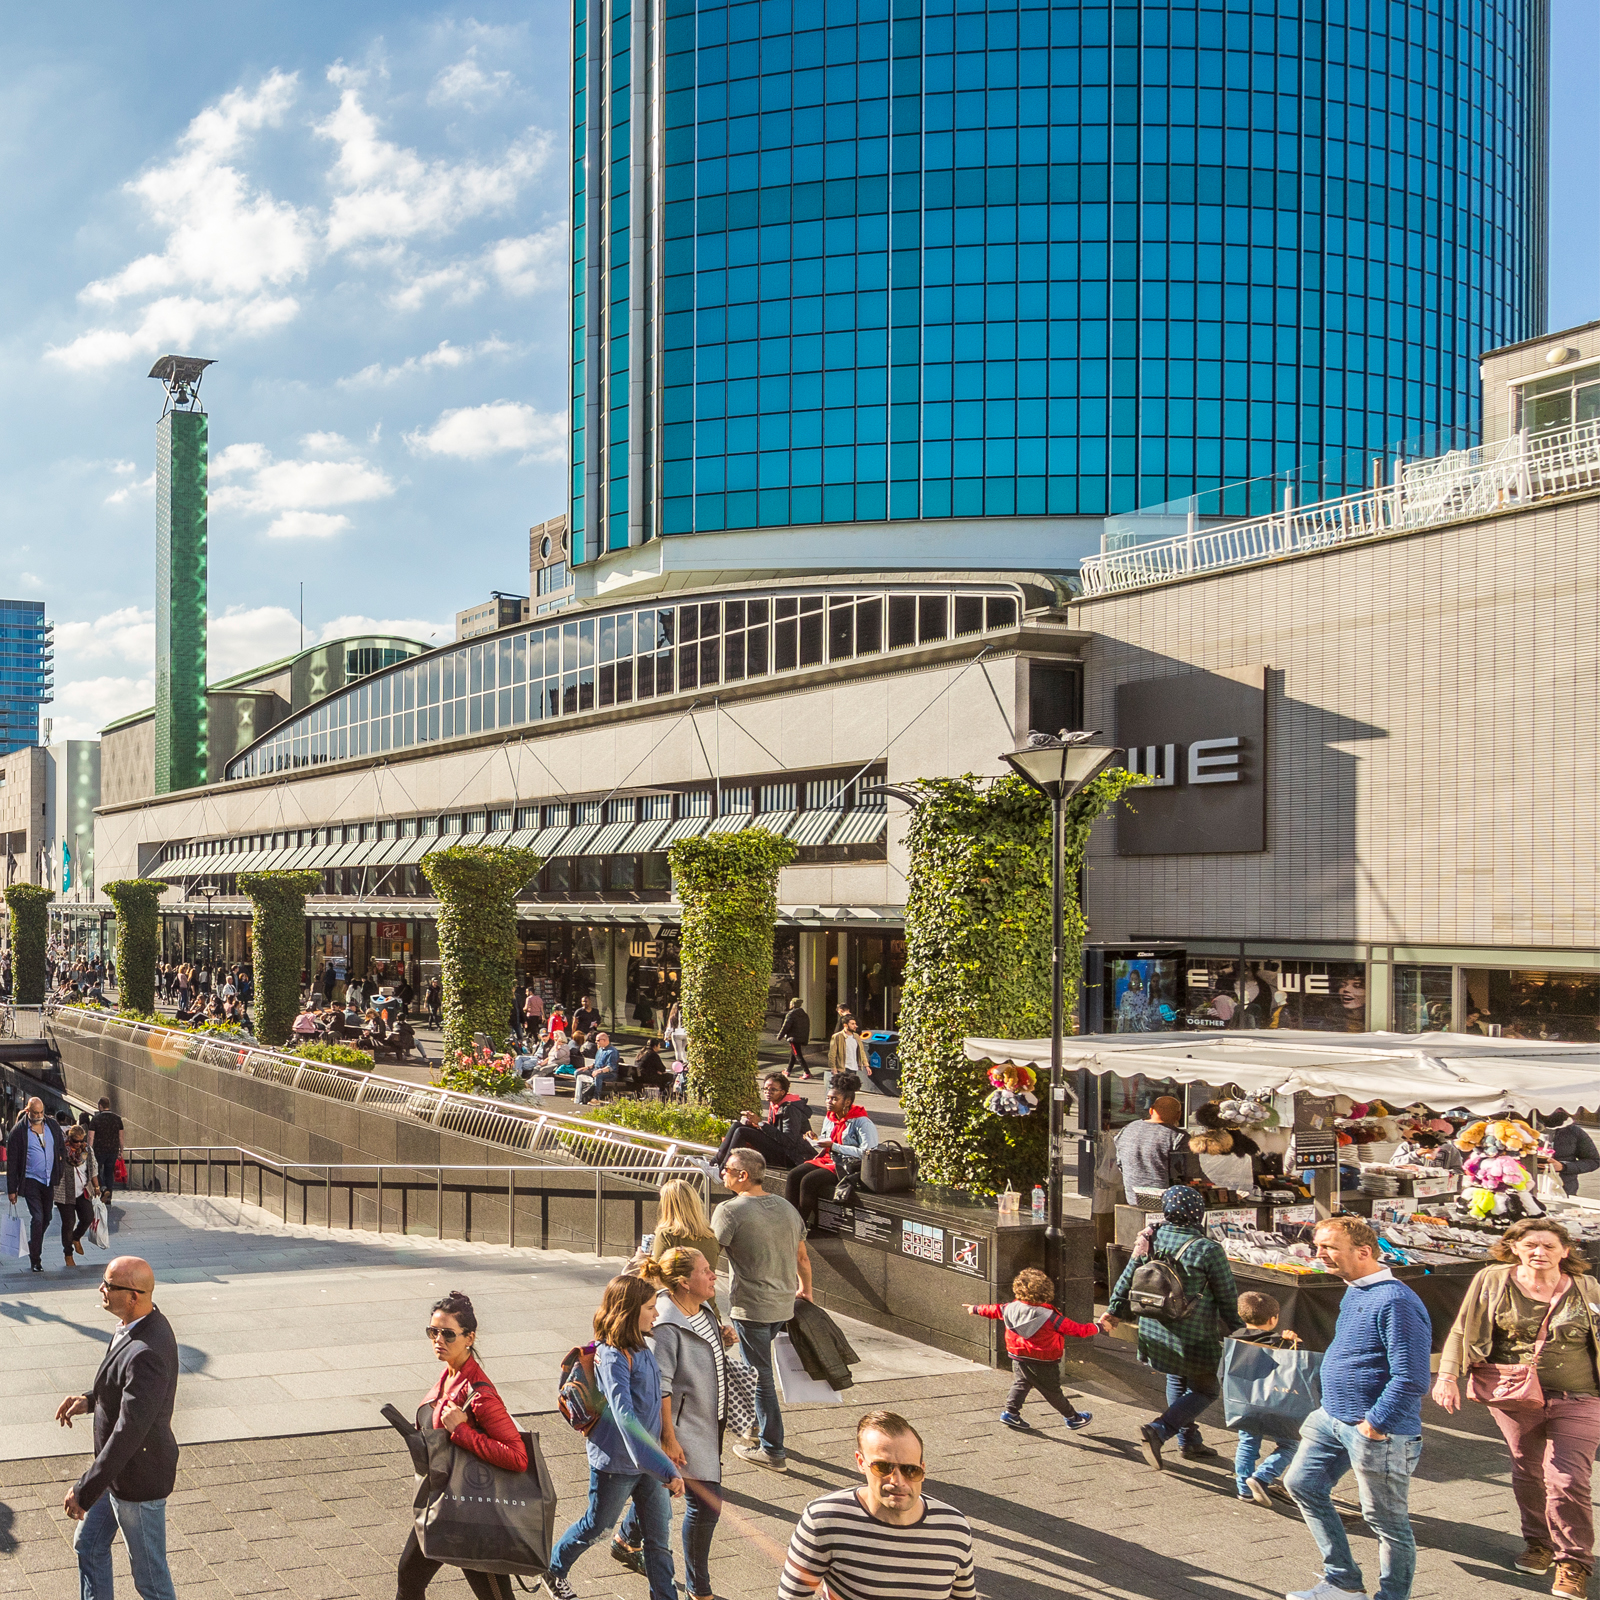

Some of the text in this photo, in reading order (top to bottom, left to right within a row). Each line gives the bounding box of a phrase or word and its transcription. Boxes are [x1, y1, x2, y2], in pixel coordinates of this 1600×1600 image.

[1128, 737, 1239, 788] WE
[661, 928, 678, 937] WE
[629, 941, 656, 958] WE
[1187, 969, 1209, 987] E
[1277, 973, 1330, 994] WE
[1186, 1017, 1225, 1027] OGETHER
